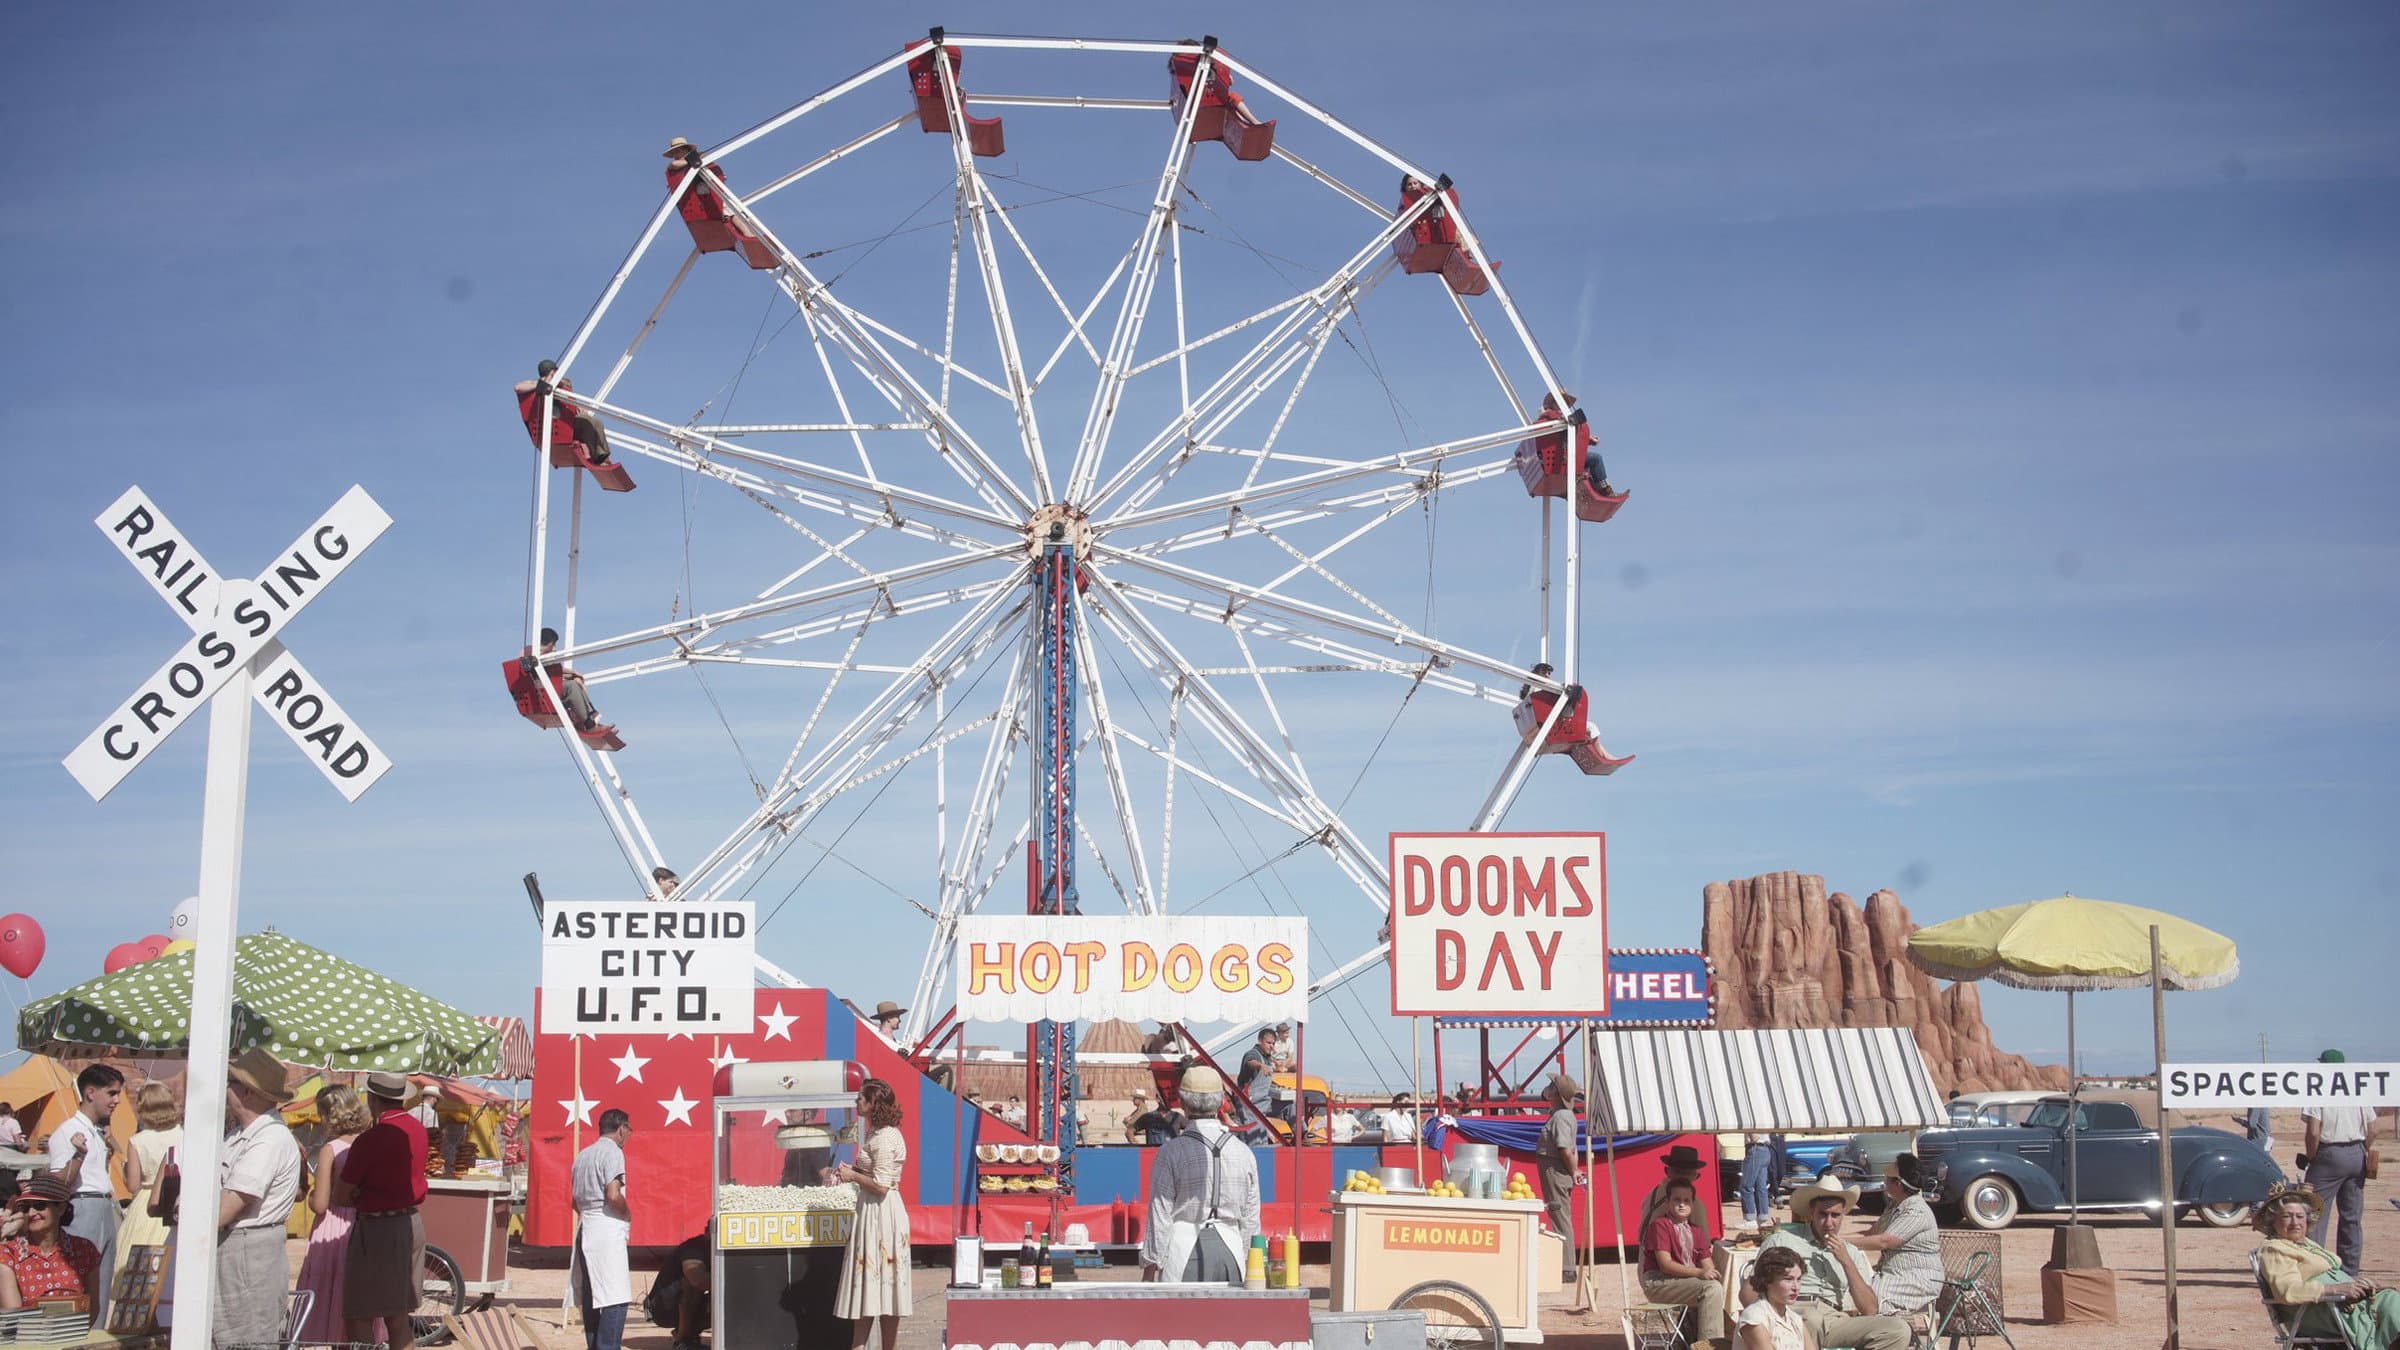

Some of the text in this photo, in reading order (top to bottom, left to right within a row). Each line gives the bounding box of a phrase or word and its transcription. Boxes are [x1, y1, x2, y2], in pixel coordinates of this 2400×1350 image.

[103, 525, 349, 761] CROSSING
[113, 504, 370, 778] RAIL ROAD
[1403, 854, 1594, 917] DOOMS
[552, 911, 745, 938] ASTEROID
[601, 949, 695, 977] CITY
[967, 940, 1295, 995] HOT DOGS
[1435, 928, 1563, 991] DAY
[1607, 972, 1705, 1000] HEEL
[577, 986, 721, 1022] U.F.O.
[2170, 1070, 2390, 1097] SPACECRAFT
[726, 1214, 851, 1245] POPCORN
[1389, 1226, 1495, 1246] LEMONADE
